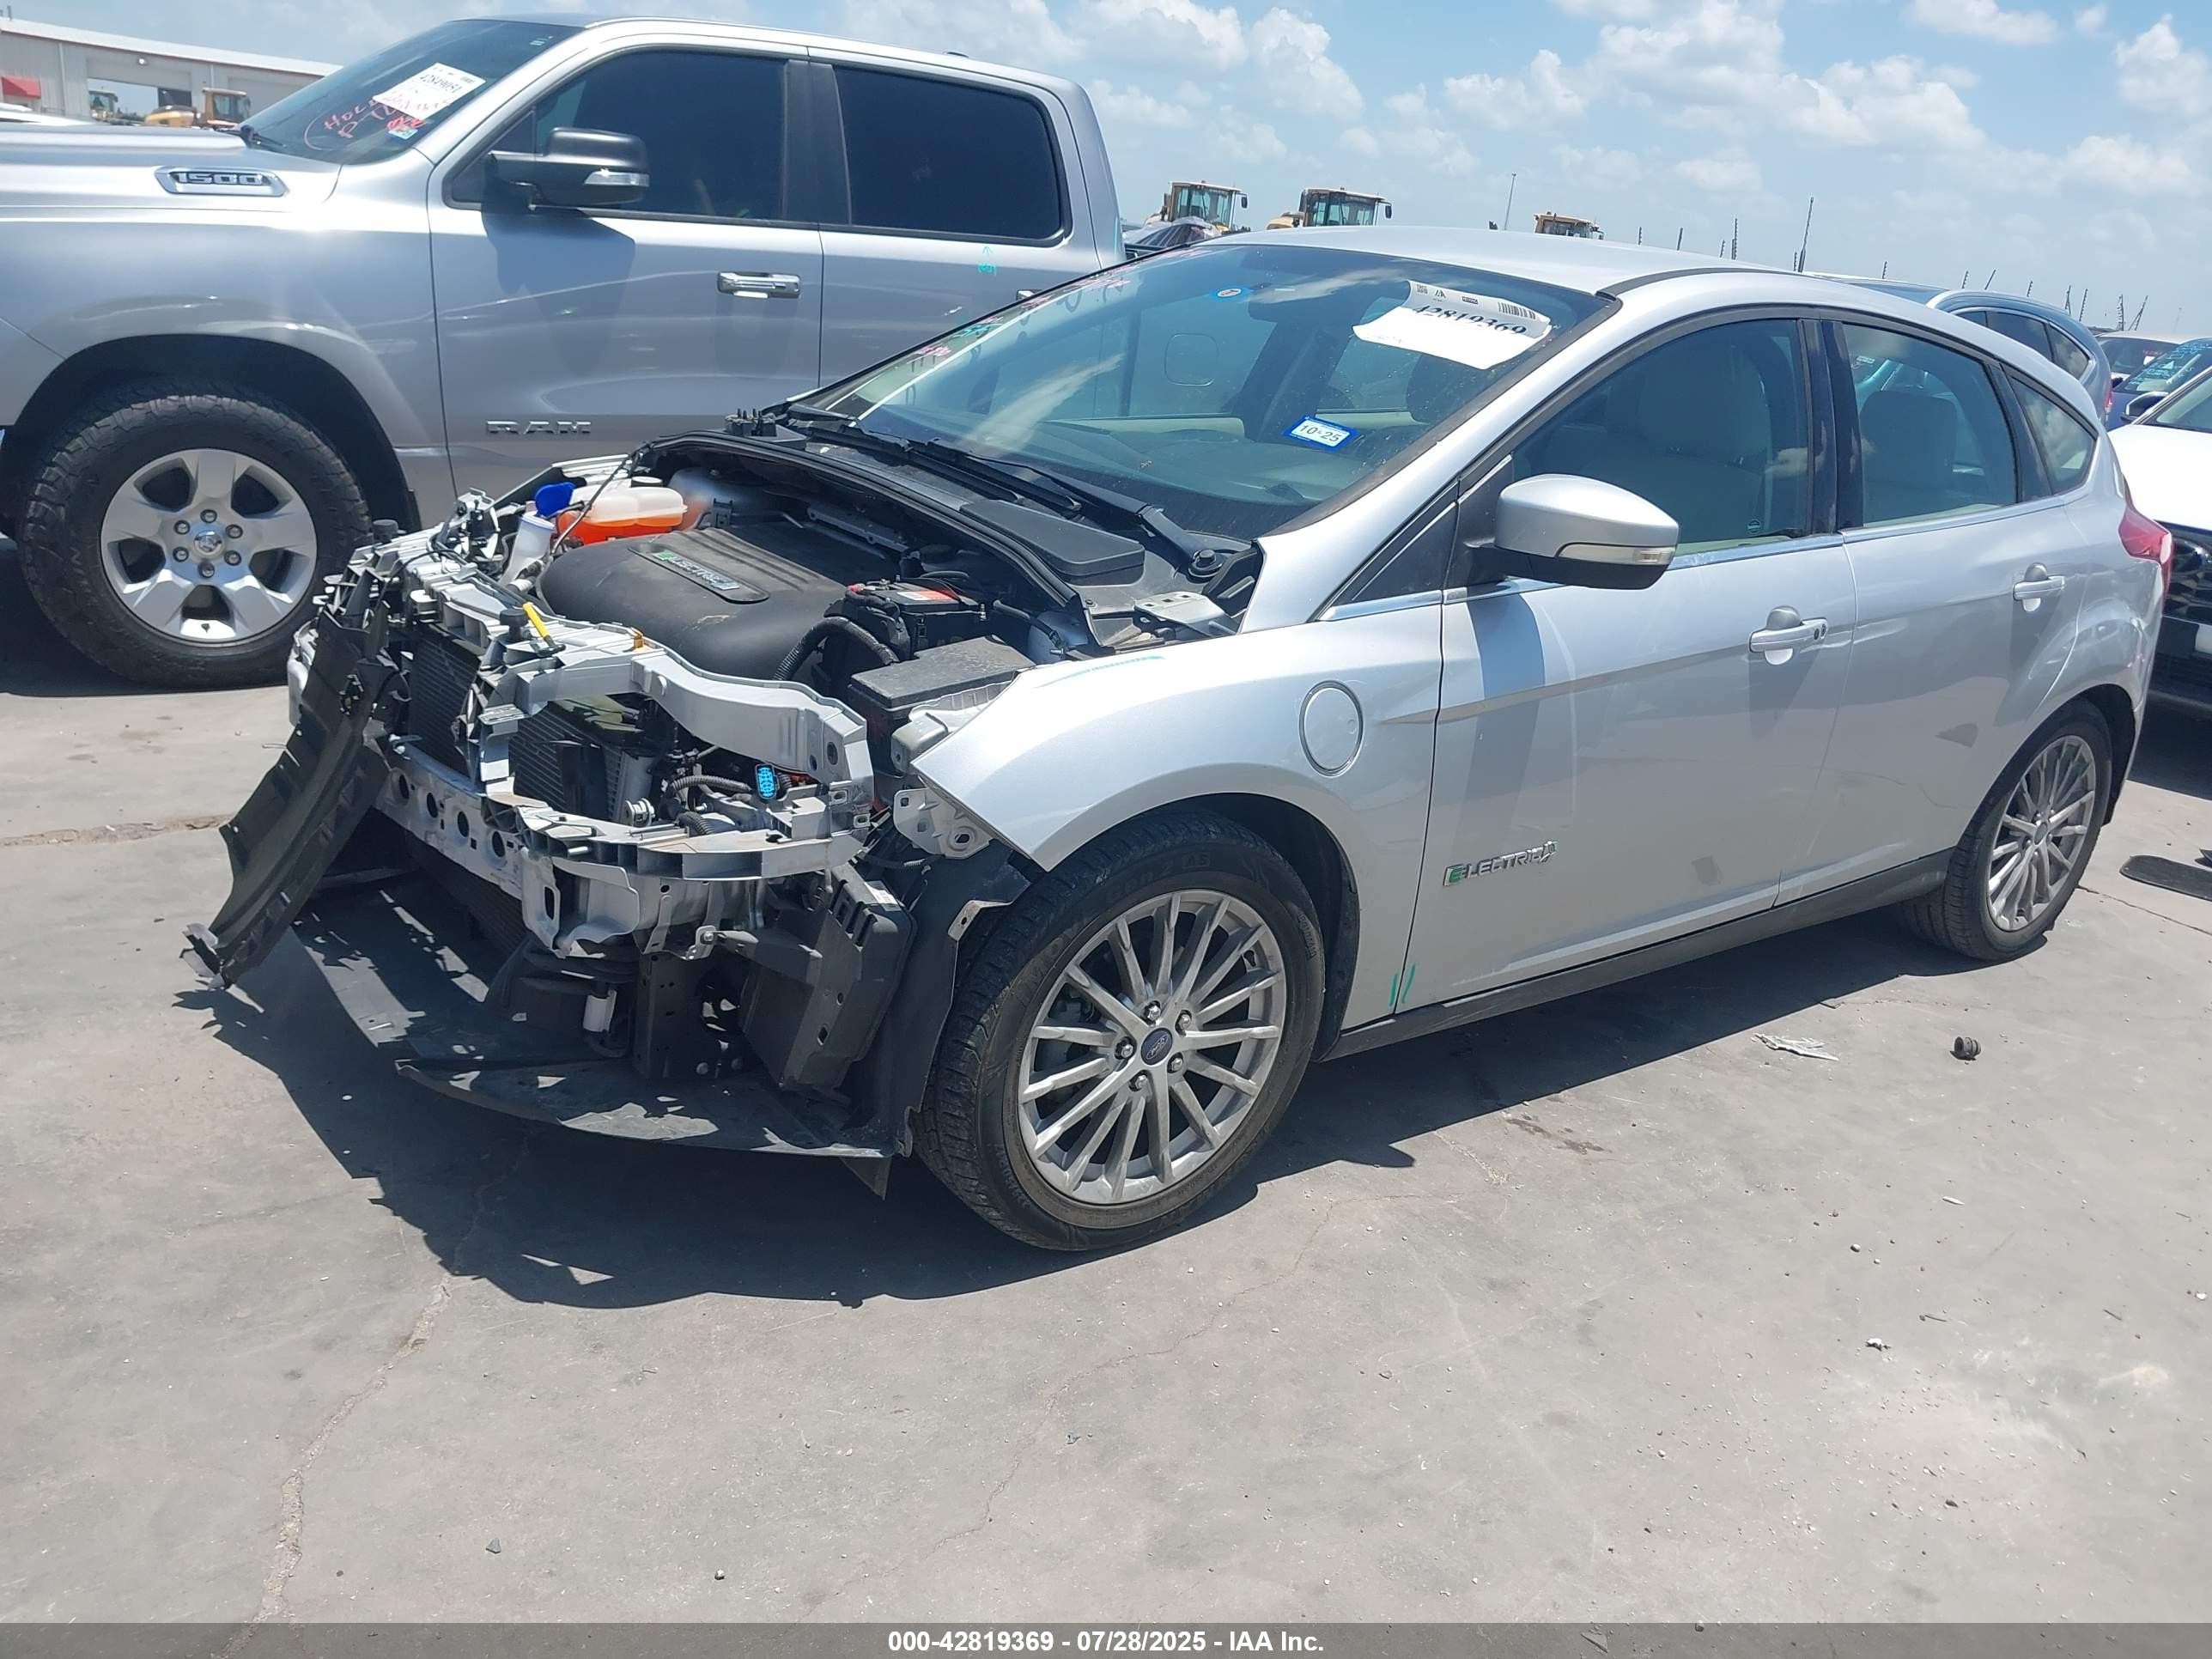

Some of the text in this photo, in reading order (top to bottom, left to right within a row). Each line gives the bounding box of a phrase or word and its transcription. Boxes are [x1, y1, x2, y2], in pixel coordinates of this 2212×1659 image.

[178, 173, 263, 185] 1500
[487, 421, 592, 434] RAM
[1443, 842, 1553, 886] ELECTRIC
